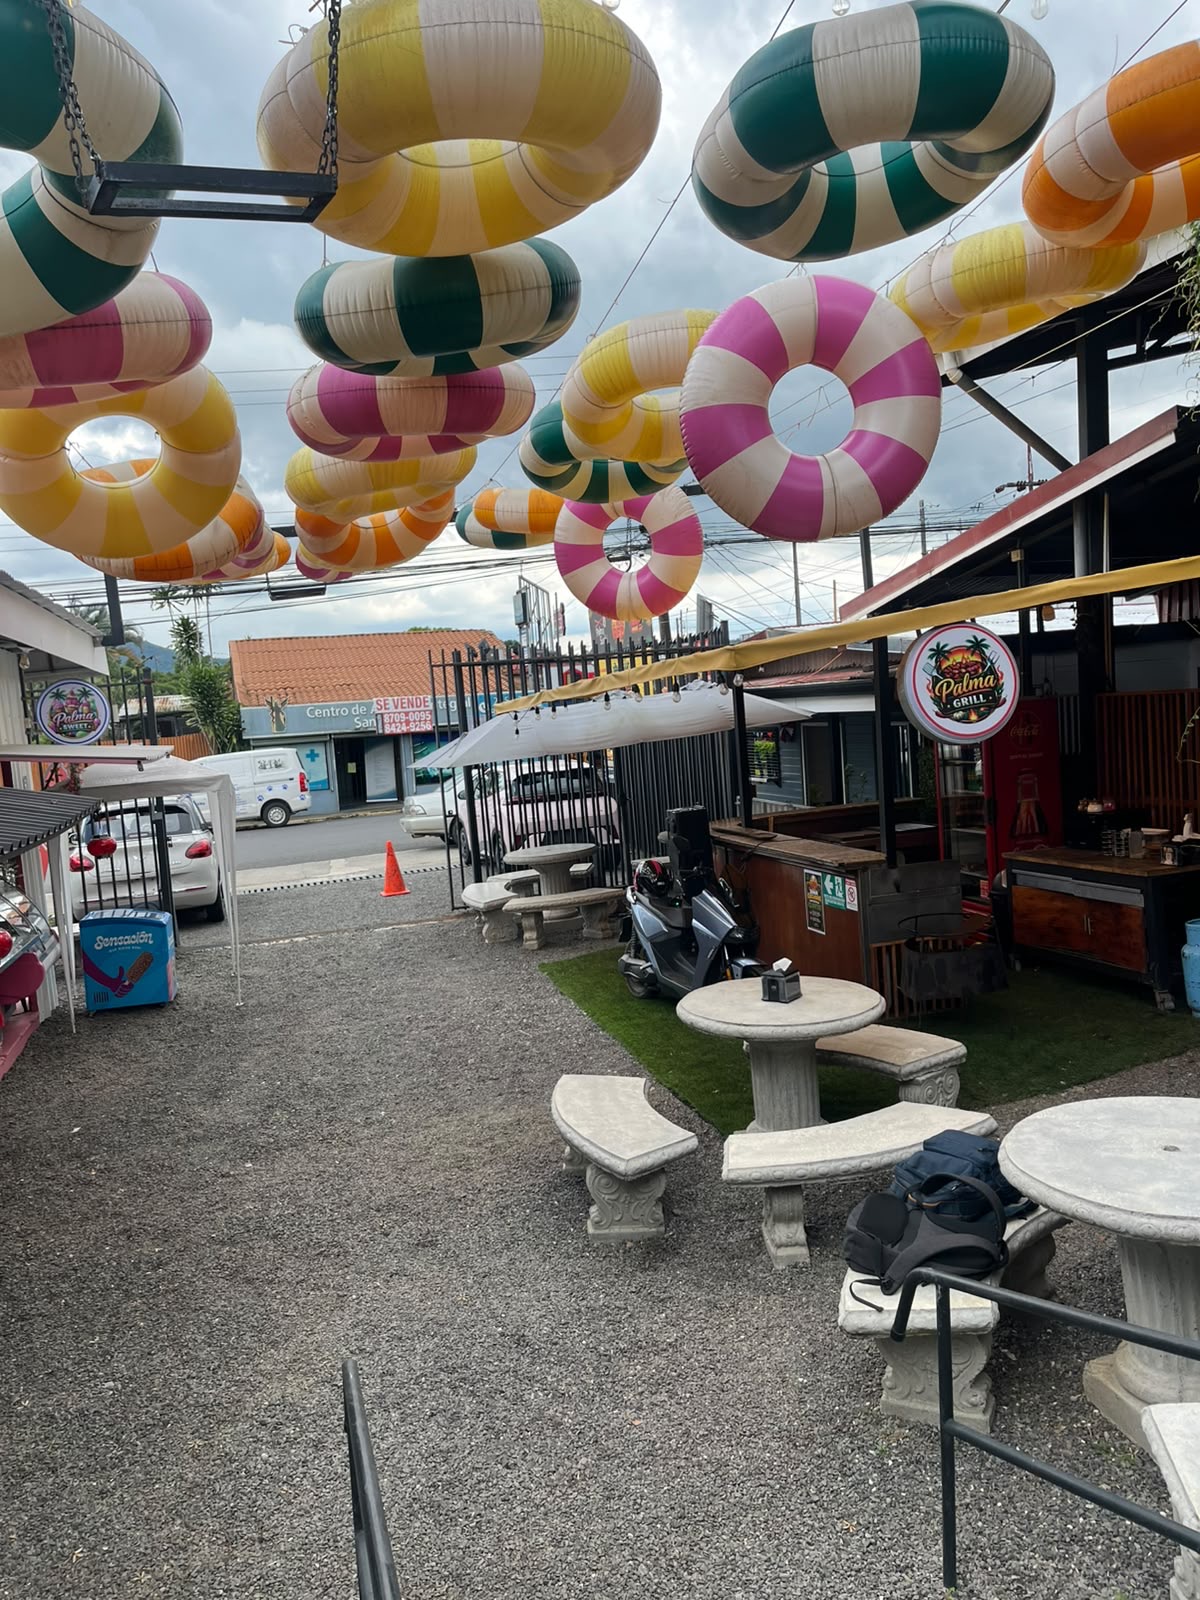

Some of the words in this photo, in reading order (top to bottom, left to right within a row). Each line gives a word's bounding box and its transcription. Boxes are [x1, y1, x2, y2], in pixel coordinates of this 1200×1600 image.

[935, 672, 997, 703] Palma
[376, 698, 389, 711] SE
[392, 696, 429, 710] VENDE
[953, 694, 987, 709] GRILL
[306, 706, 349, 718] Centro
[351, 703, 367, 715] de
[383, 711, 432, 723] 8709-0095
[53, 710, 96, 727] Palma
[94, 931, 154, 950] Sensación
